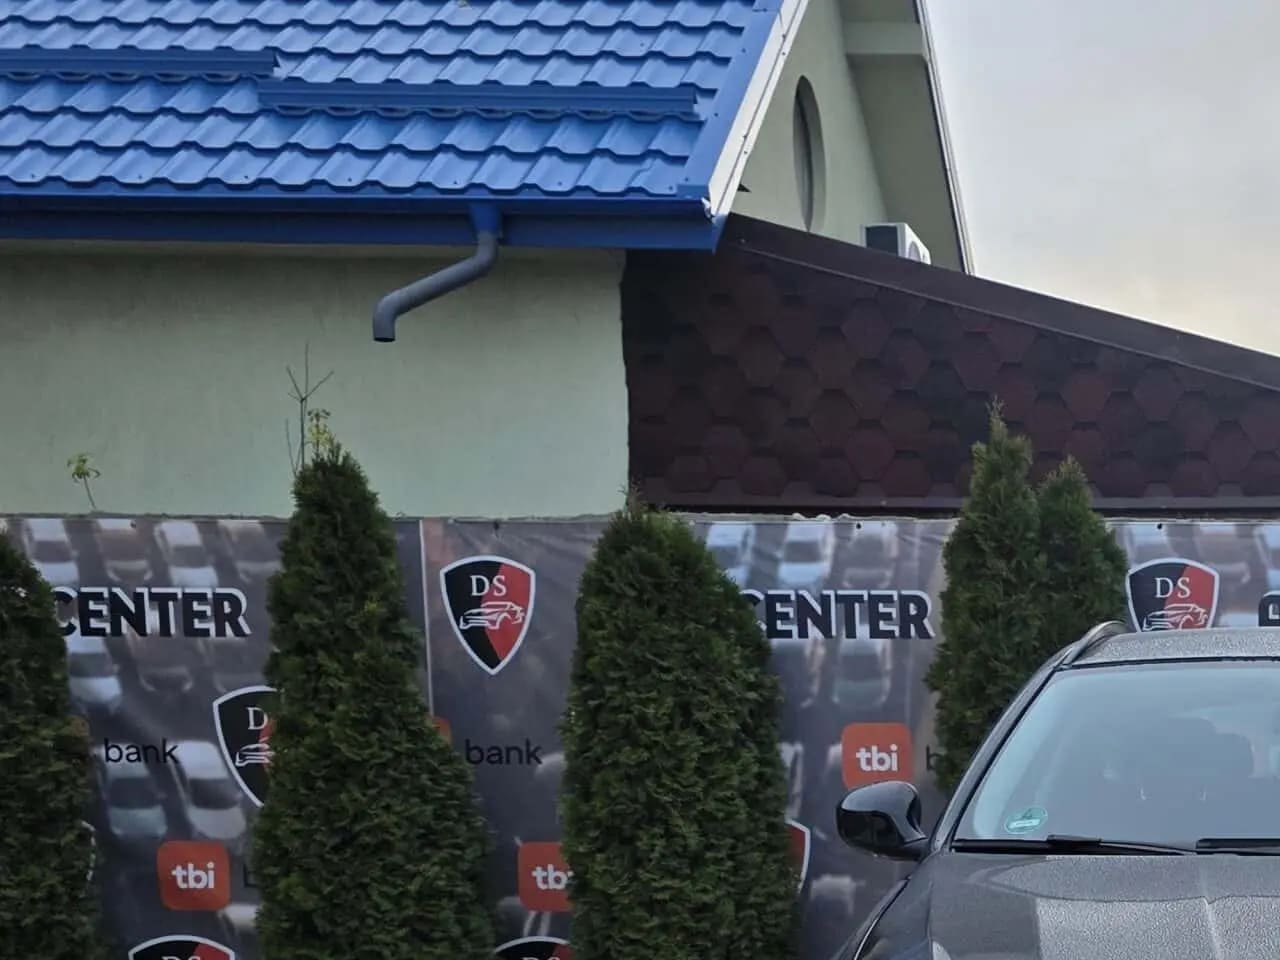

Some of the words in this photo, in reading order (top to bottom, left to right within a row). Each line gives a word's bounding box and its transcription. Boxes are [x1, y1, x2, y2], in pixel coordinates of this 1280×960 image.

[470, 574, 508, 597] DS
[1154, 575, 1192, 599] DS
[104, 738, 180, 764] bank
[464, 739, 542, 766] bank
[855, 743, 899, 772] tbi
[171, 861, 215, 890] tbi
